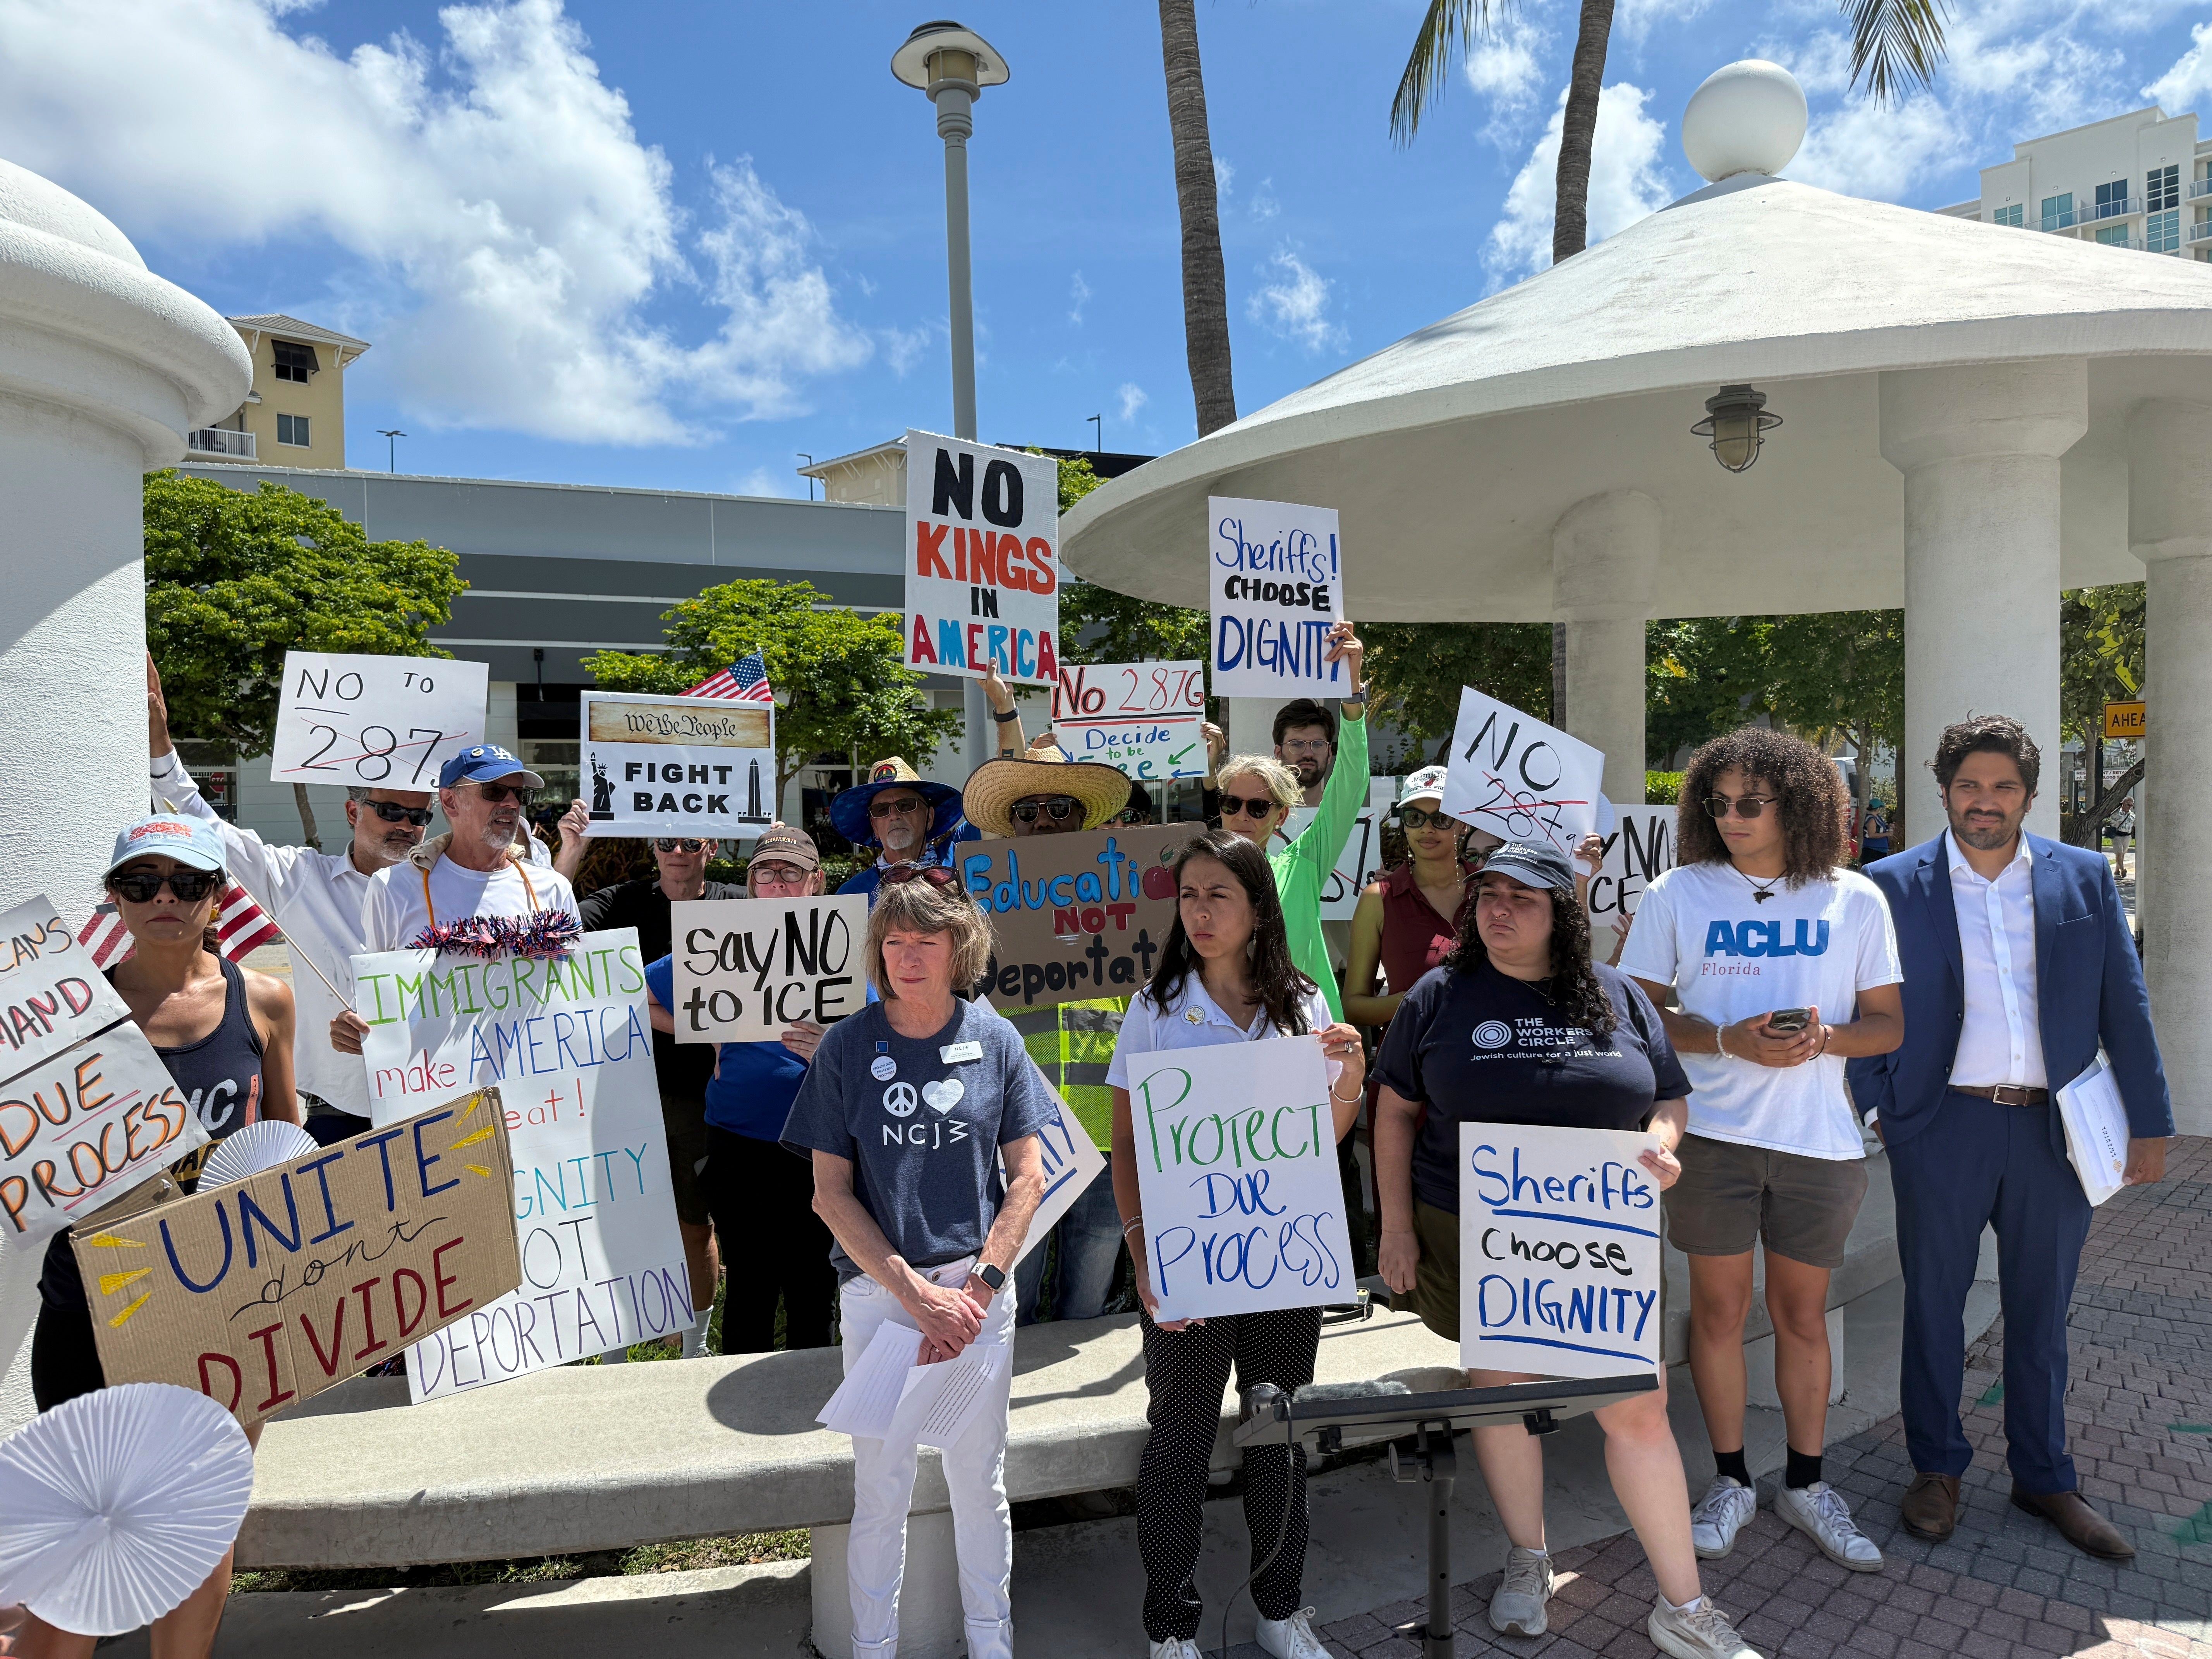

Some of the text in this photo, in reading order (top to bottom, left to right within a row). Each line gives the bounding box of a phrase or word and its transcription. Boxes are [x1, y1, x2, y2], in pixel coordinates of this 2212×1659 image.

[932, 448, 1024, 528] NO
[917, 521, 1055, 595] KINGS
[1216, 518, 1337, 583] Sheriffs!
[971, 587, 999, 619] IN
[1224, 575, 1331, 612] CHOOSE
[911, 614, 1058, 681] AMERICA
[296, 669, 363, 700] NO
[1118, 668, 1204, 711] 287G
[623, 711, 657, 734] We
[678, 715, 738, 742] People
[1086, 725, 1171, 750] Decide
[2112, 712, 2145, 727] AHEA
[301, 725, 443, 788] 287
[487, 746, 515, 762] LA
[625, 762, 732, 785] FIGHT
[1105, 746, 1144, 760] to be
[1464, 711, 1561, 792] NO
[634, 792, 730, 814] BACK
[764, 836, 797, 845] HUMAN
[964, 836, 1140, 913] Educati
[1589, 874, 1643, 916] CE
[785, 908, 849, 976] NO
[1053, 903, 1136, 934] NOT
[1704, 919, 1829, 957] ACLU
[357, 945, 644, 1026] IMMIGRANTS
[974, 928, 1158, 1005] Deportat
[1701, 962, 1761, 975] Florida
[683, 976, 852, 1031] to ICE
[1514, 1018, 1544, 1027] THE
[376, 1005, 651, 1098] make AMERICA
[1470, 1052, 1504, 1061] Jewish
[1573, 1049, 1593, 1058] just
[1516, 1027, 1593, 1037] WORKERS
[1518, 1037, 1575, 1046] CIRCLE
[0, 1053, 115, 1161] DUE
[505, 1078, 586, 1130] eat!
[0, 1086, 187, 1233] PROCESS
[513, 1143, 647, 1220] GNITY
[159, 1110, 460, 1293] UNITE
[523, 1216, 593, 1290] OT
[198, 1236, 473, 1413] DIVIDE
[416, 1262, 694, 1396] DEPORTATION
[1479, 1274, 1657, 1341] DIGNITY
